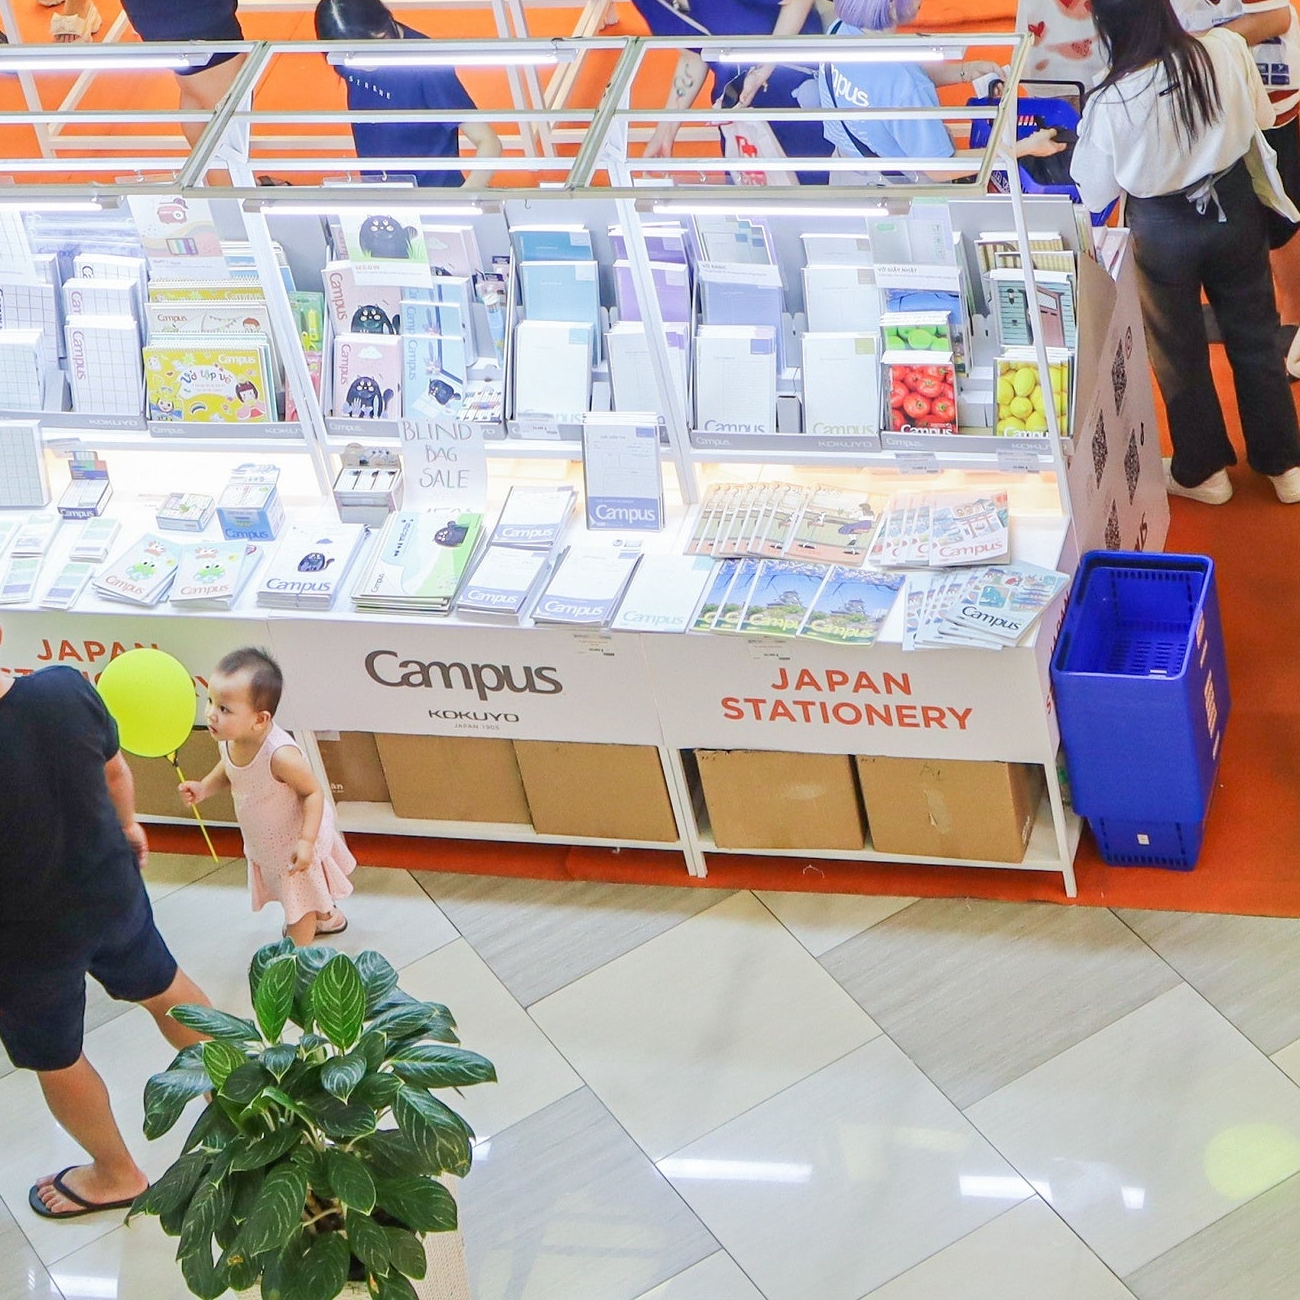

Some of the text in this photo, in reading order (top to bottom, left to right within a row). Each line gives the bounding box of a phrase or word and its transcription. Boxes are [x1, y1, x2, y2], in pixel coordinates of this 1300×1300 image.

[330, 272, 348, 321] Campus
[157, 313, 187, 323] Campus
[406, 306, 418, 335] Camp
[72, 330, 86, 380] Campus
[217, 355, 257, 366] Campus
[407, 339, 418, 381] Campus
[340, 343, 352, 386] Campus
[403, 420, 472, 441] BLIND
[704, 419, 764, 433] Campus
[900, 424, 953, 436] Campus
[695, 435, 873, 448] Campus KOKUYO
[426, 444, 458, 462] BAG
[420, 468, 470, 489] SALE
[61, 507, 95, 519] Campus
[595, 504, 656, 522] Campus
[224, 526, 269, 540] Campus
[501, 525, 554, 540] Campus
[939, 540, 1003, 558] Campus
[104, 574, 145, 596] Campus
[180, 581, 229, 596] Campus
[266, 578, 331, 592] Campus
[371, 572, 385, 594] Campus
[467, 589, 517, 605] Campus
[544, 600, 604, 617] Campus
[622, 609, 685, 626] Campus
[961, 605, 1021, 632] Campus
[811, 618, 872, 638] Campus
[364, 649, 563, 701] Campus
[771, 666, 912, 696] JAPAN
[428, 709, 520, 723] KOKUYO
[721, 696, 973, 731] STATIONERY
